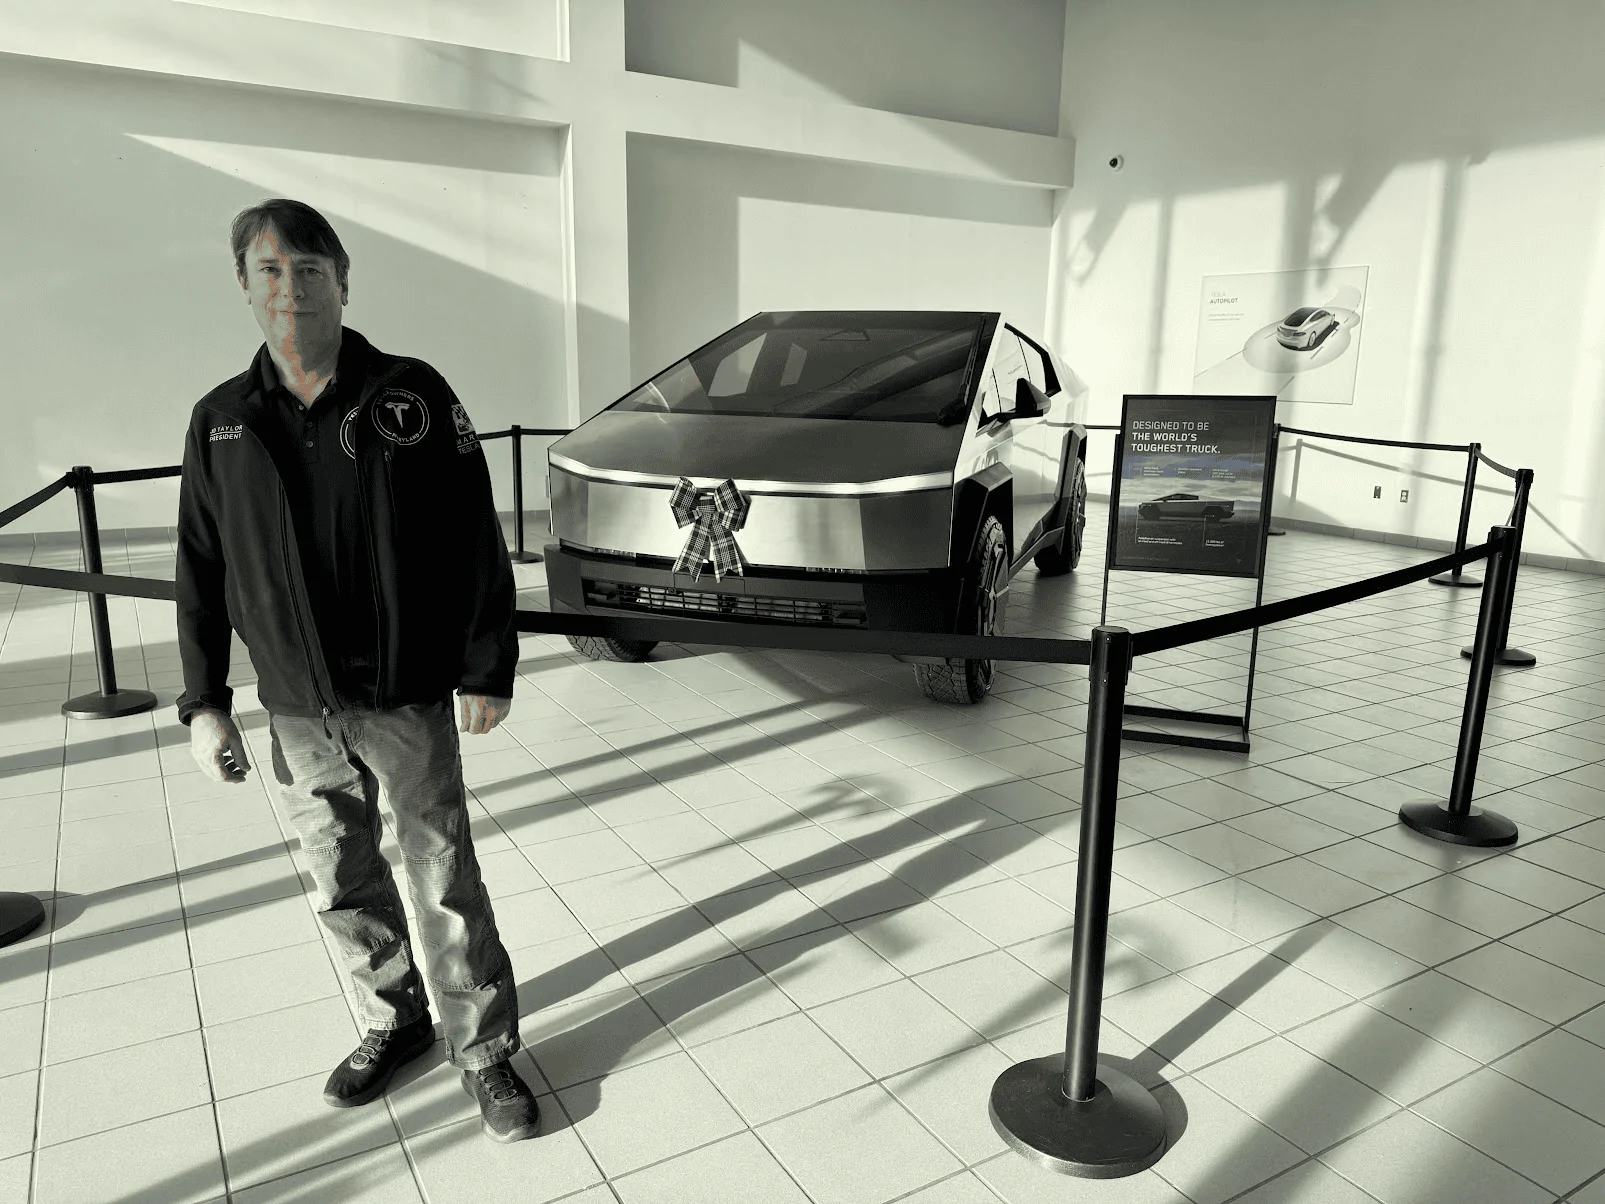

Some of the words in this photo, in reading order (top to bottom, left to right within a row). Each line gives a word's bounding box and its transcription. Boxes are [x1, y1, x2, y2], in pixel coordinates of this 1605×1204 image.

[1132, 421, 1180, 430] DESIGNED
[1182, 422, 1195, 431] TO
[1197, 422, 1210, 431] BE
[209, 433, 242, 442] PRESIDENT
[1132, 432, 1150, 441] THE
[1153, 433, 1198, 442] WORLD'S
[1131, 443, 1183, 453] TOUGHEST
[1186, 445, 1221, 454] TRUCK.
